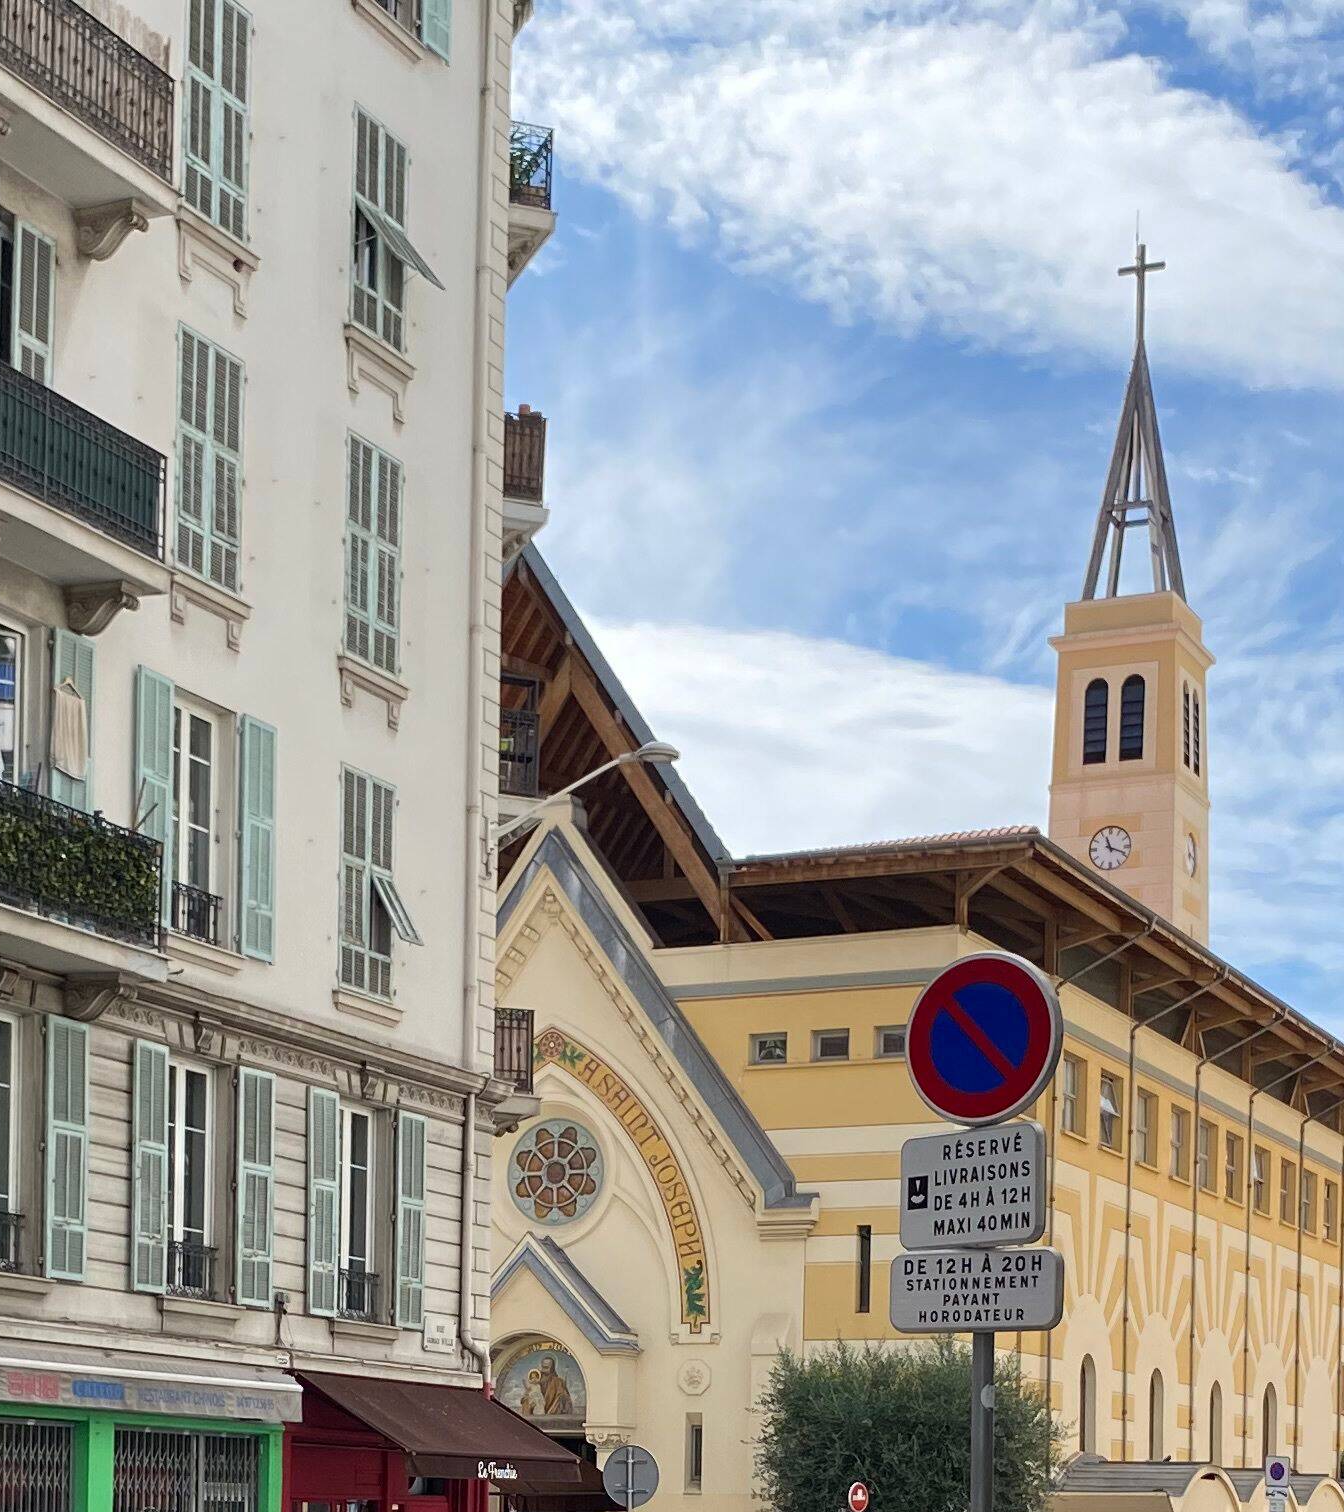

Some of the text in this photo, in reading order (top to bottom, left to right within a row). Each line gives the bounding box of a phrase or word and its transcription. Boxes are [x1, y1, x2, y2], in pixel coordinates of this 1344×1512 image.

[942, 1132, 1023, 1161] RÉSERVÉ
[594, 1072, 662, 1147] SAINT
[648, 1152, 703, 1259] JOSEPH
[933, 1160, 1031, 1187] LIVRAISONS
[933, 1184, 1031, 1212] DE 4H À 12H
[933, 1218, 971, 1237] MAXI
[904, 1252, 1043, 1276] DE 12H À 20H
[905, 1275, 1039, 1292] STATIONNEMENT
[942, 1292, 1000, 1307] PAYANT
[918, 1307, 1025, 1324] HORODATEUR
[478, 1461, 488, 1479] Le
